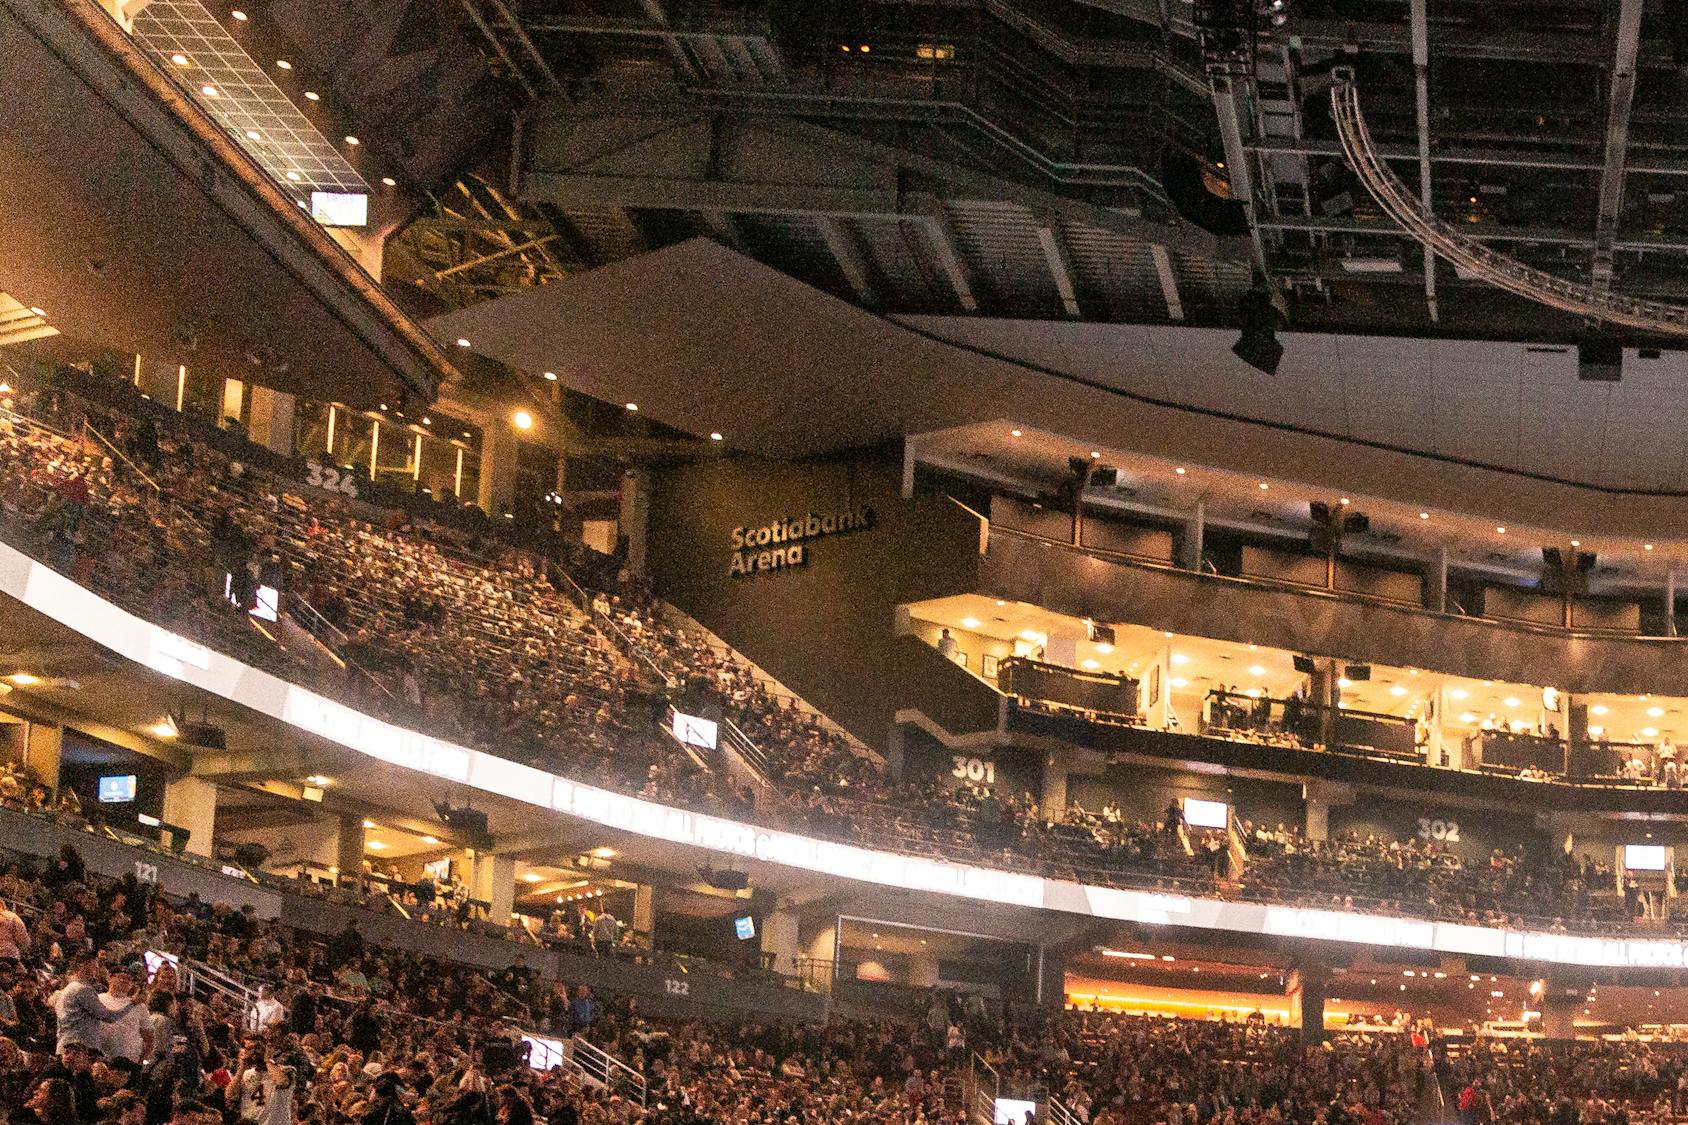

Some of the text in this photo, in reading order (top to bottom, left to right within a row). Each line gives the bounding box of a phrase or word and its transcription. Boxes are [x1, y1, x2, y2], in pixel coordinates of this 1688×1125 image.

[730, 511, 870, 551] Scotiabank
[730, 545, 803, 575] Arena
[952, 756, 995, 784] 301
[1418, 817, 1460, 842] 302
[665, 980, 689, 995] 122
[250, 1083, 265, 1106] 4
